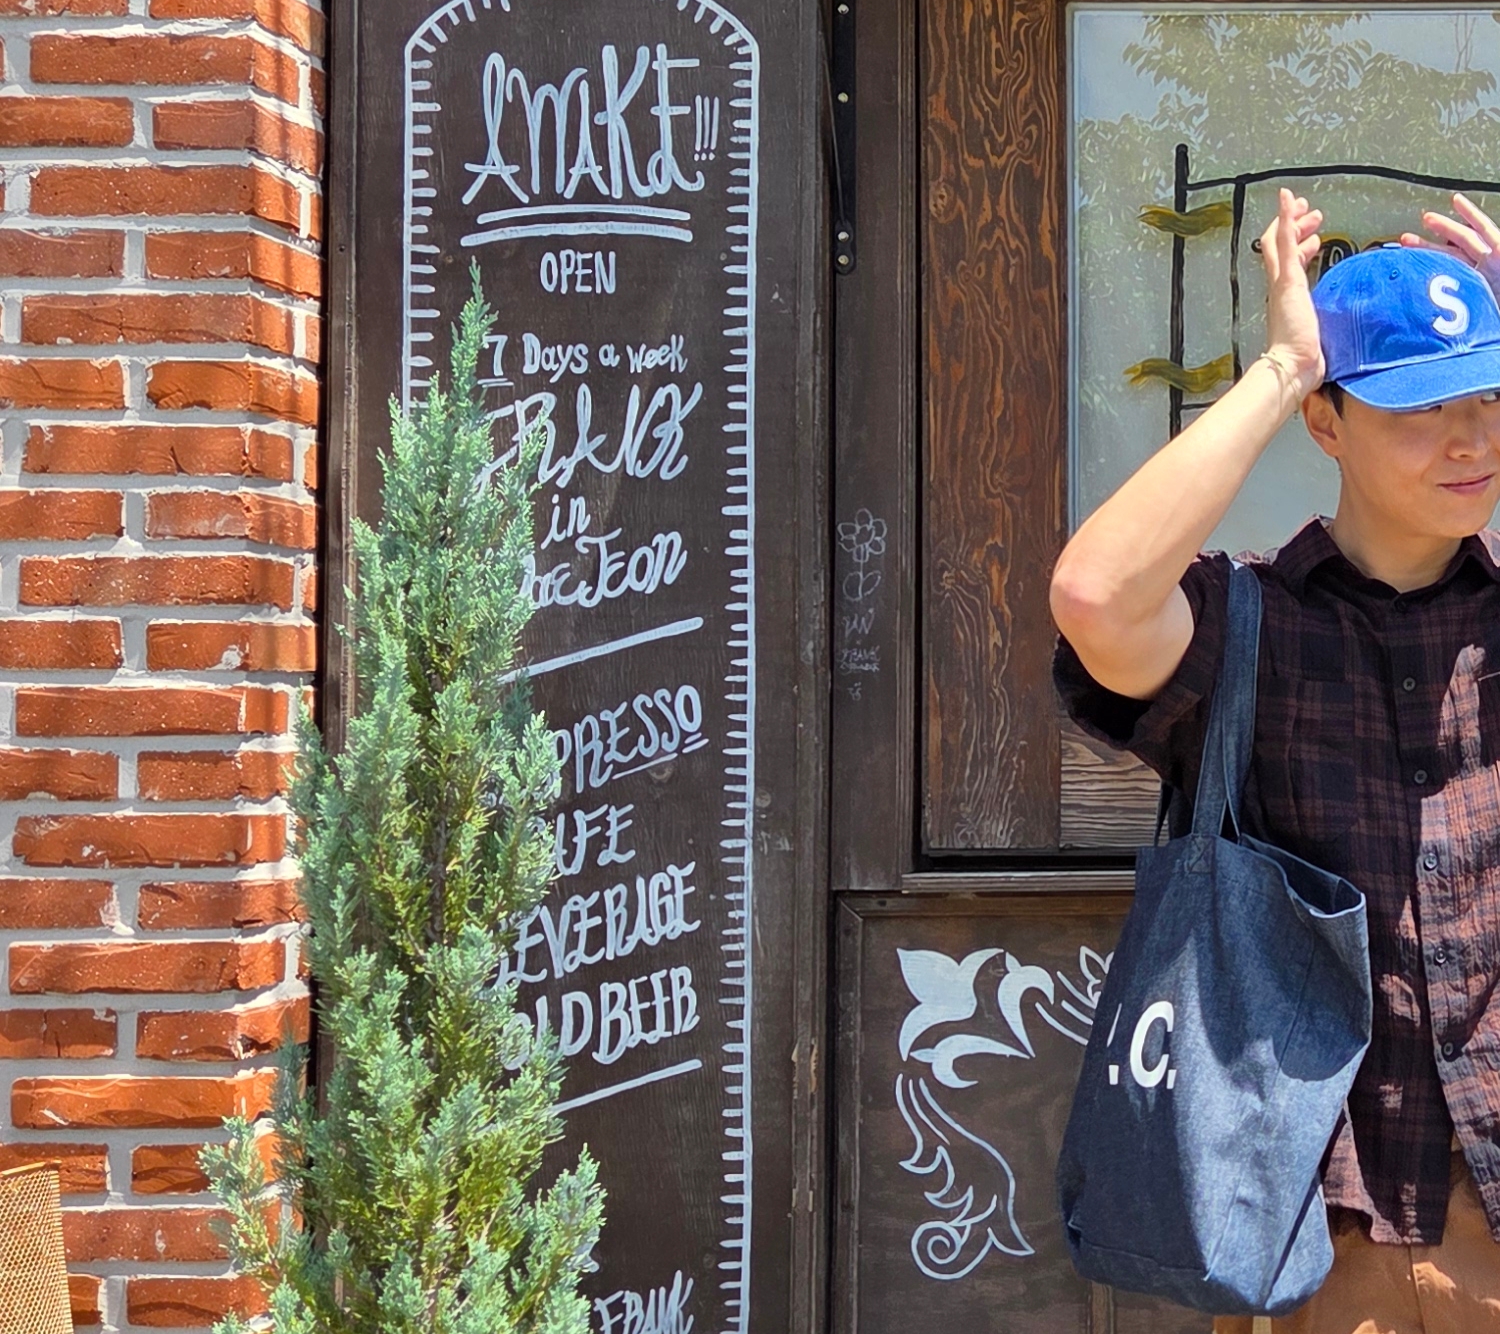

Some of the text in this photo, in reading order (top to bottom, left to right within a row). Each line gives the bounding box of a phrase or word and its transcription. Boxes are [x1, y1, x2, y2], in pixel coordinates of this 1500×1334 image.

[540, 249, 617, 294] OPEN
[1429, 274, 1470, 336] S
[484, 334, 509, 376] 7
[522, 333, 589, 383] Days
[599, 343, 620, 368] a
[541, 494, 591, 549] in
